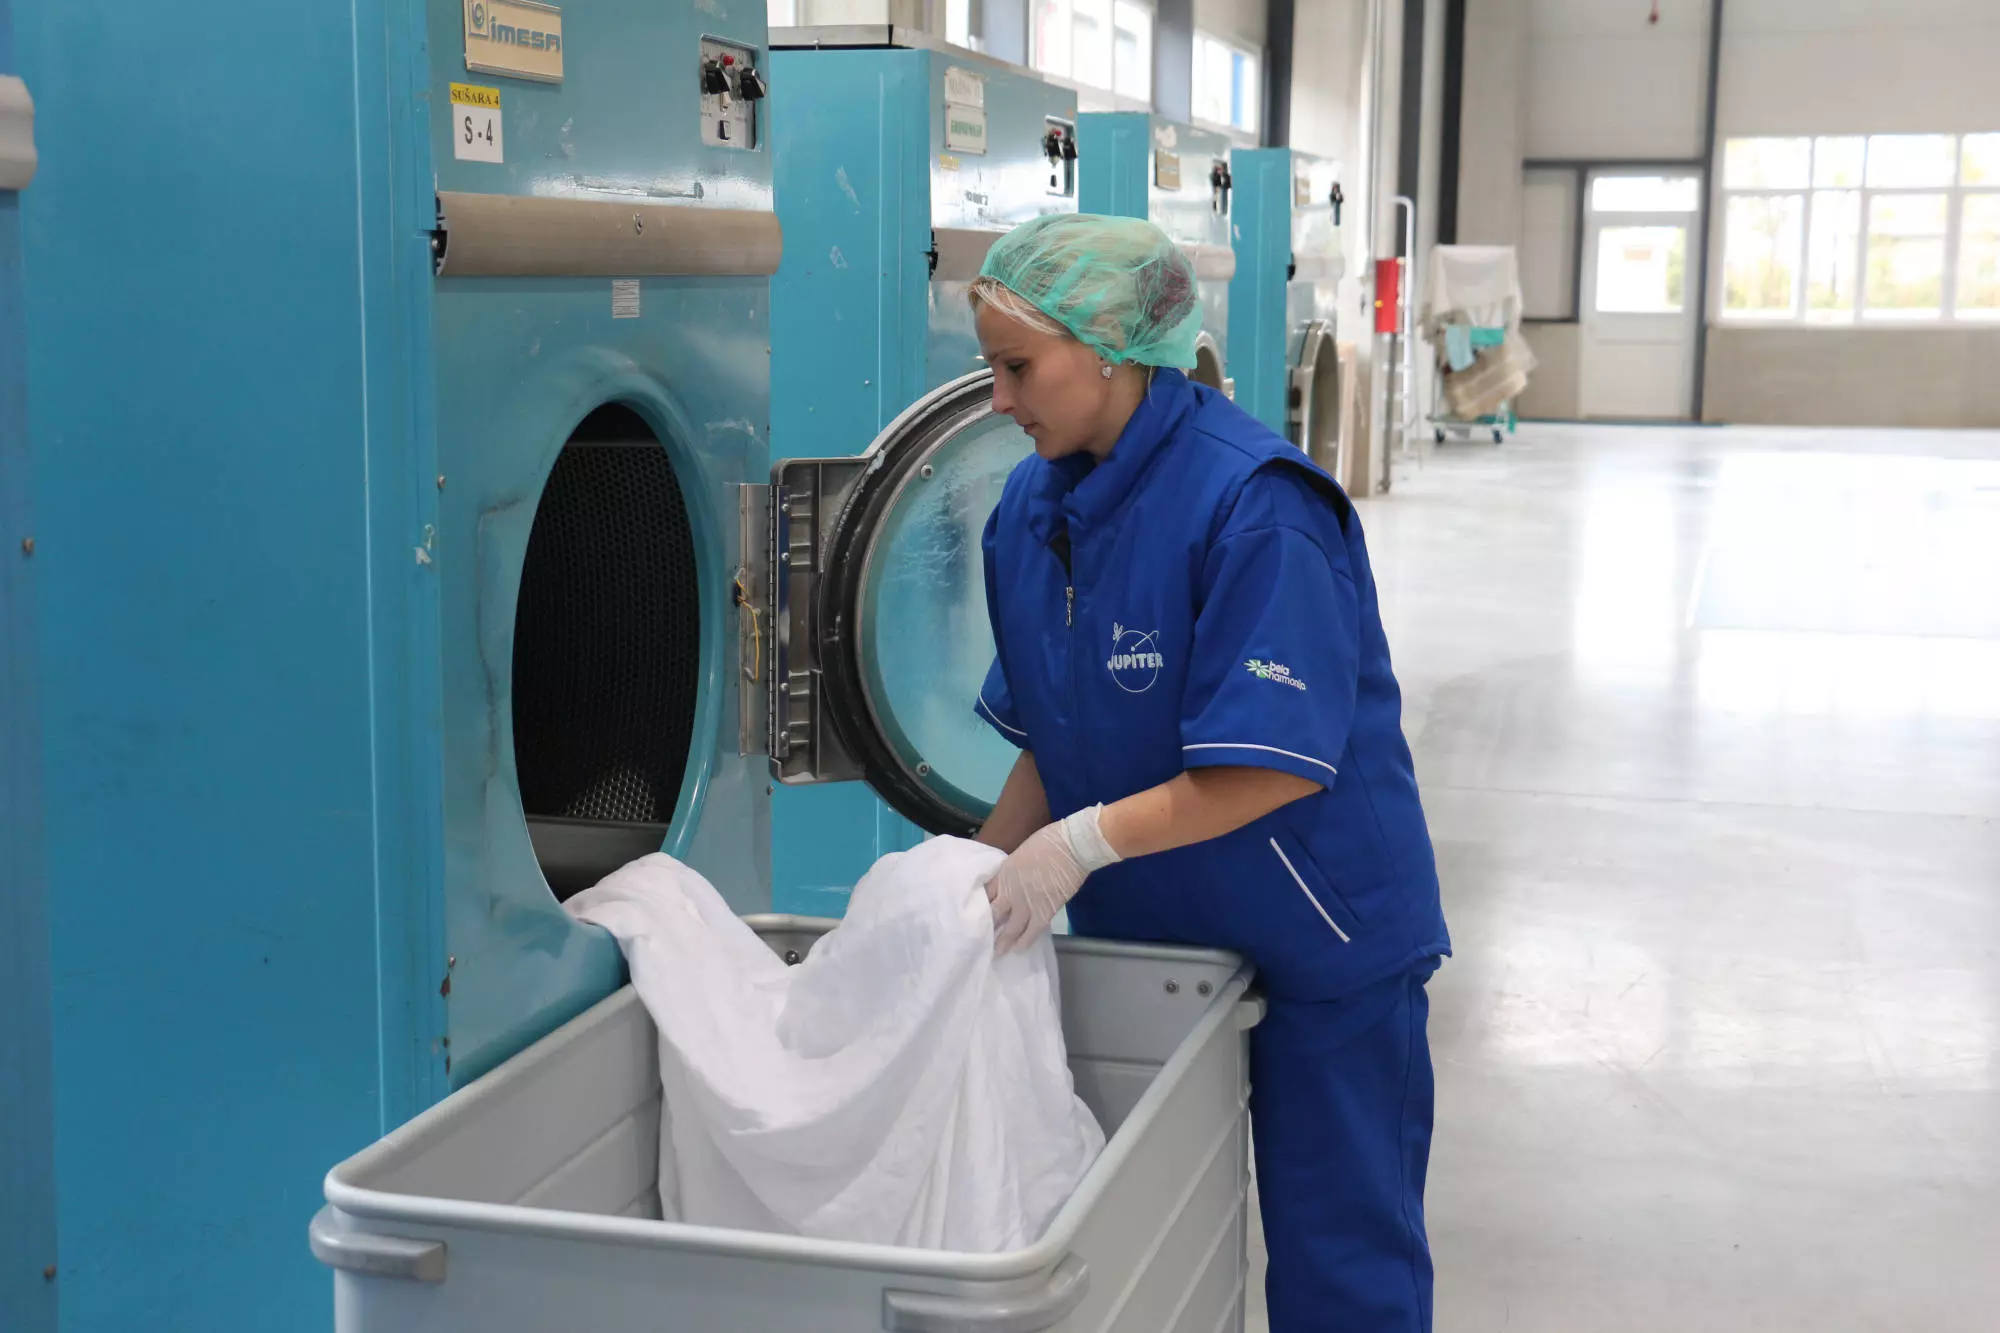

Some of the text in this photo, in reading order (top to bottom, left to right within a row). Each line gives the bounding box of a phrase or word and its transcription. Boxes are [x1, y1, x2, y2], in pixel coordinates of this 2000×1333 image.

[451, 88, 499, 105] SUŠARA 4
[1269, 660, 1290, 676] bela
